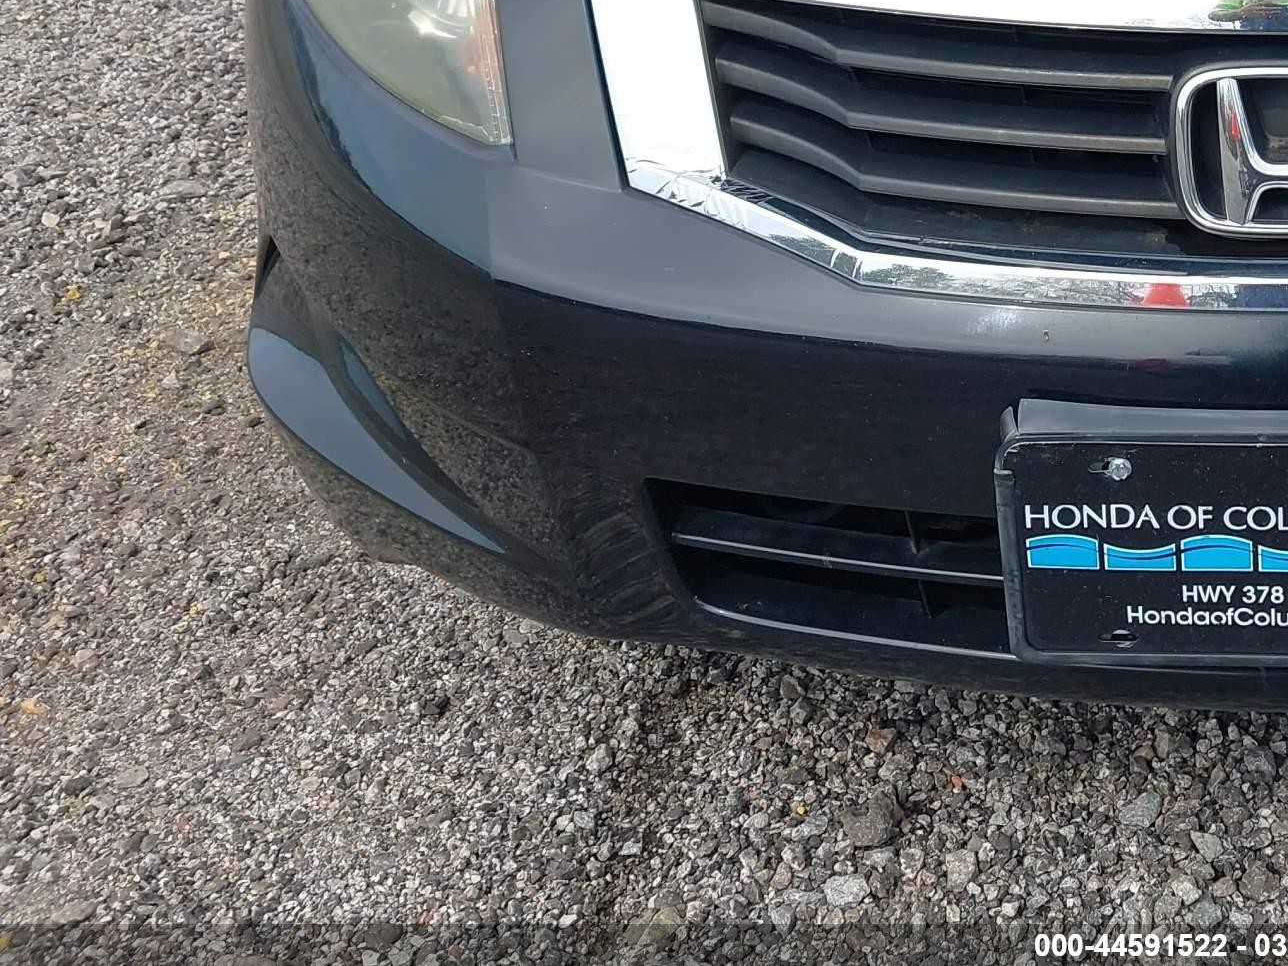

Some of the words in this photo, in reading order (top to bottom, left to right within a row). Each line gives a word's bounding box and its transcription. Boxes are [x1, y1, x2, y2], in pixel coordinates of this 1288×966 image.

[1024, 503, 1161, 531] HONDA
[1167, 504, 1213, 531] OF
[1182, 584, 1236, 603] HWY
[1242, 585, 1285, 604] 378
